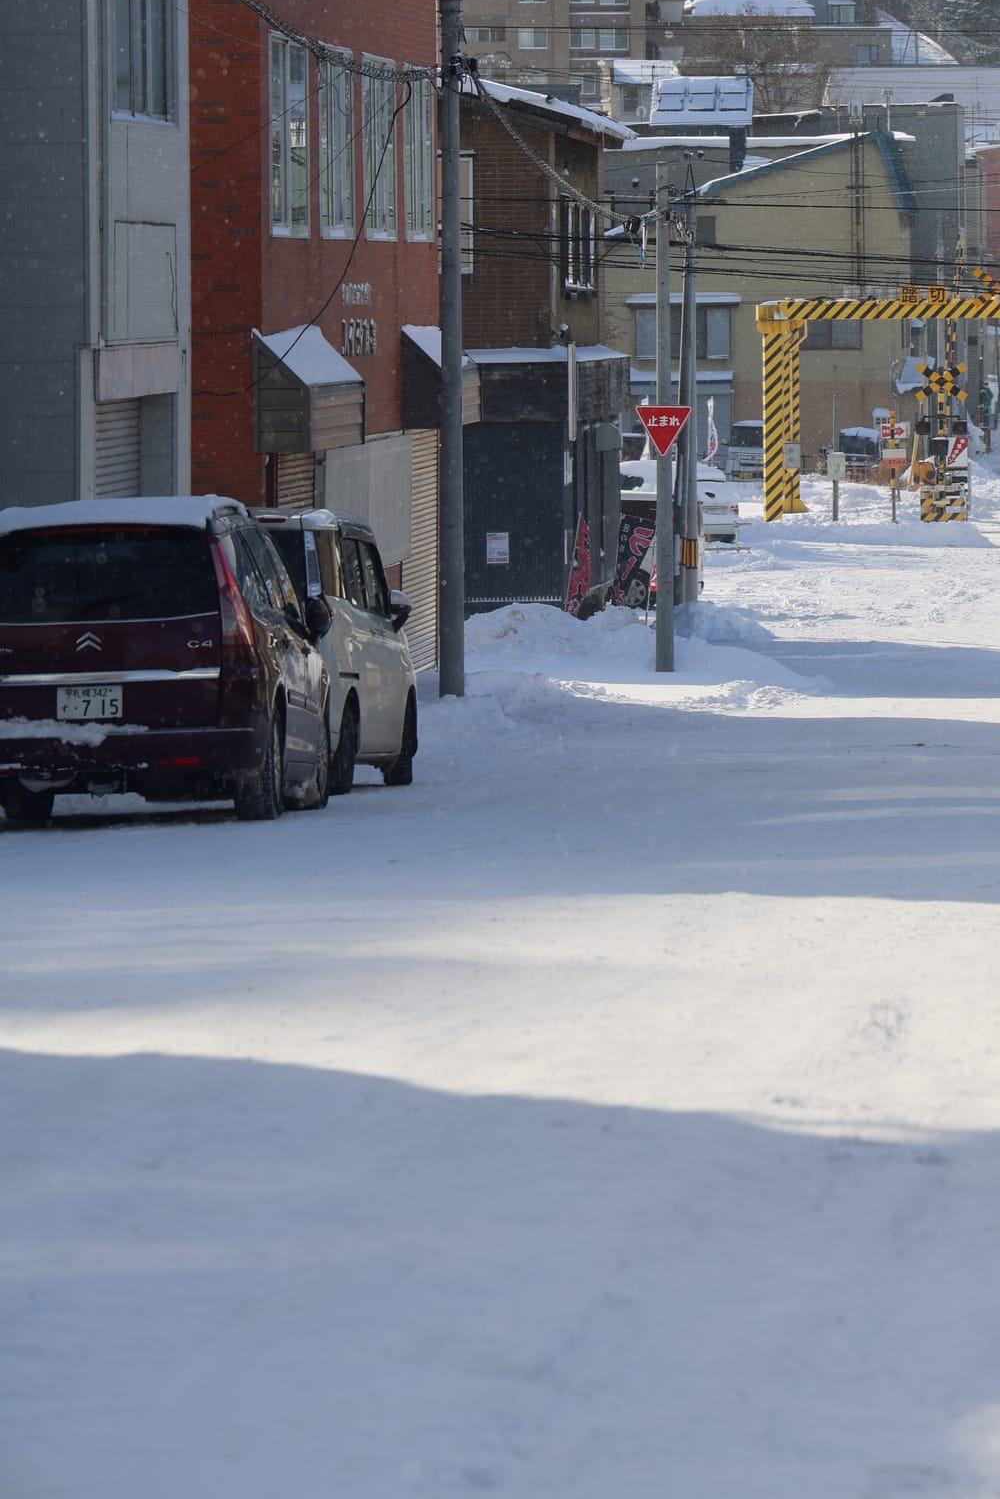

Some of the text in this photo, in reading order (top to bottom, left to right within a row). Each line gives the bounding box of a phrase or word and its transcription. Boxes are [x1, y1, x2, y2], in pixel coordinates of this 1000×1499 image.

[901, 286, 946, 303] 踏切
[647, 415, 680, 427] 止まれ
[187, 639, 213, 649] C4
